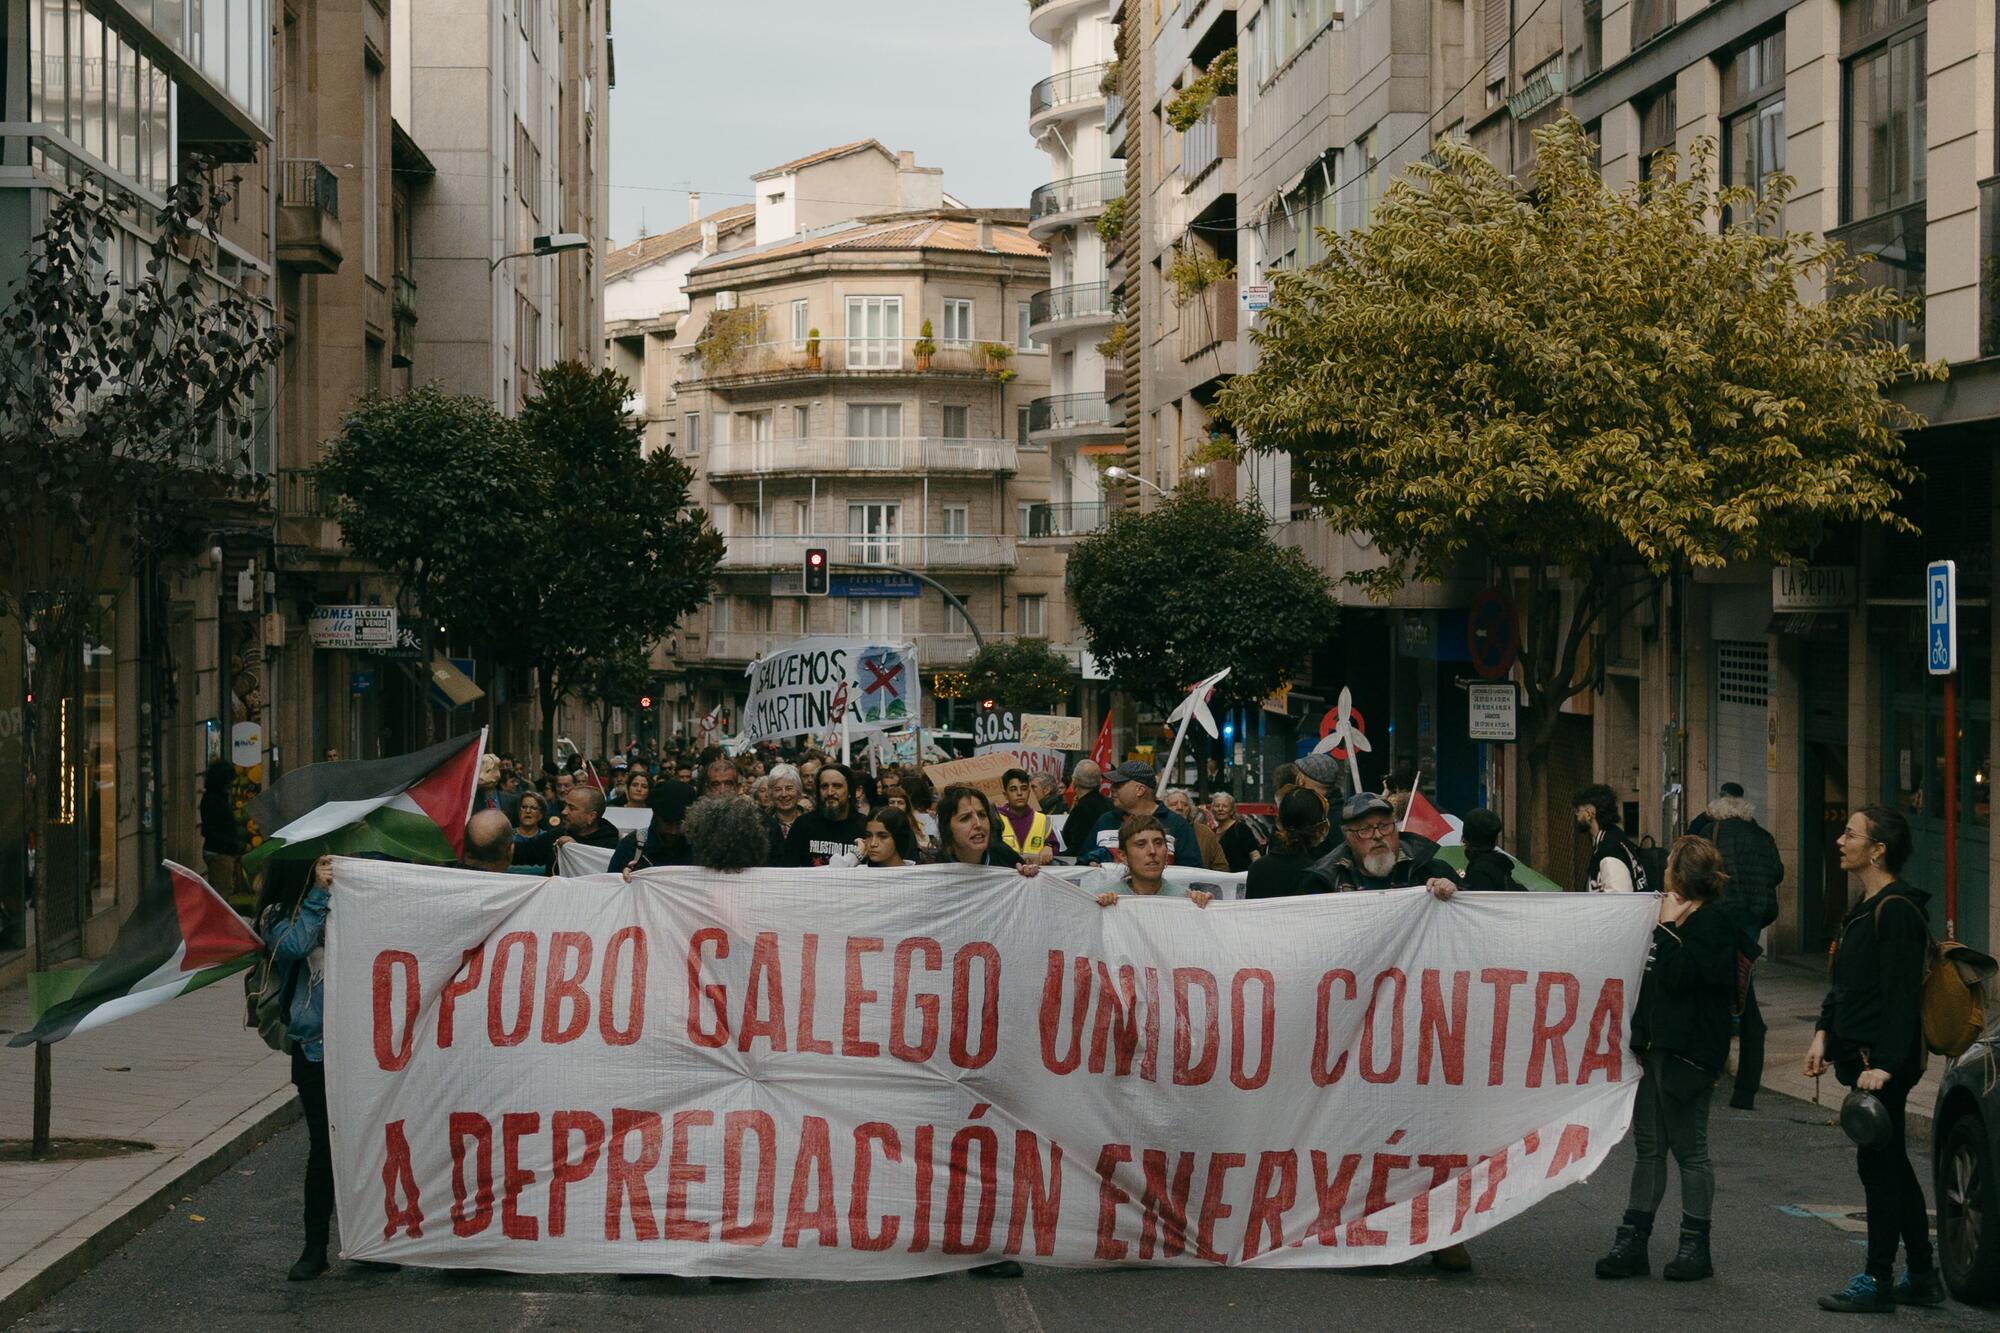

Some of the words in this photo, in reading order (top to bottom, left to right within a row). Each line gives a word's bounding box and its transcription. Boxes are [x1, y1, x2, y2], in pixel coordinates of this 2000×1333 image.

[1782, 569, 1797, 596] LA
[1799, 569, 1846, 596] PEPITA
[1934, 580, 1944, 619] P
[756, 649, 848, 695] SALVEMOS
[975, 711, 1020, 746] S.O.S.
[372, 949, 421, 1072] O
[437, 926, 647, 1049] POBO
[687, 927, 1002, 1069] GALEGO
[1039, 949, 1276, 1090] UNIDO
[1309, 967, 1624, 1088] CONTRA
[382, 1118, 425, 1241] A
[448, 1103, 1064, 1256] DEPREDACIÓN
